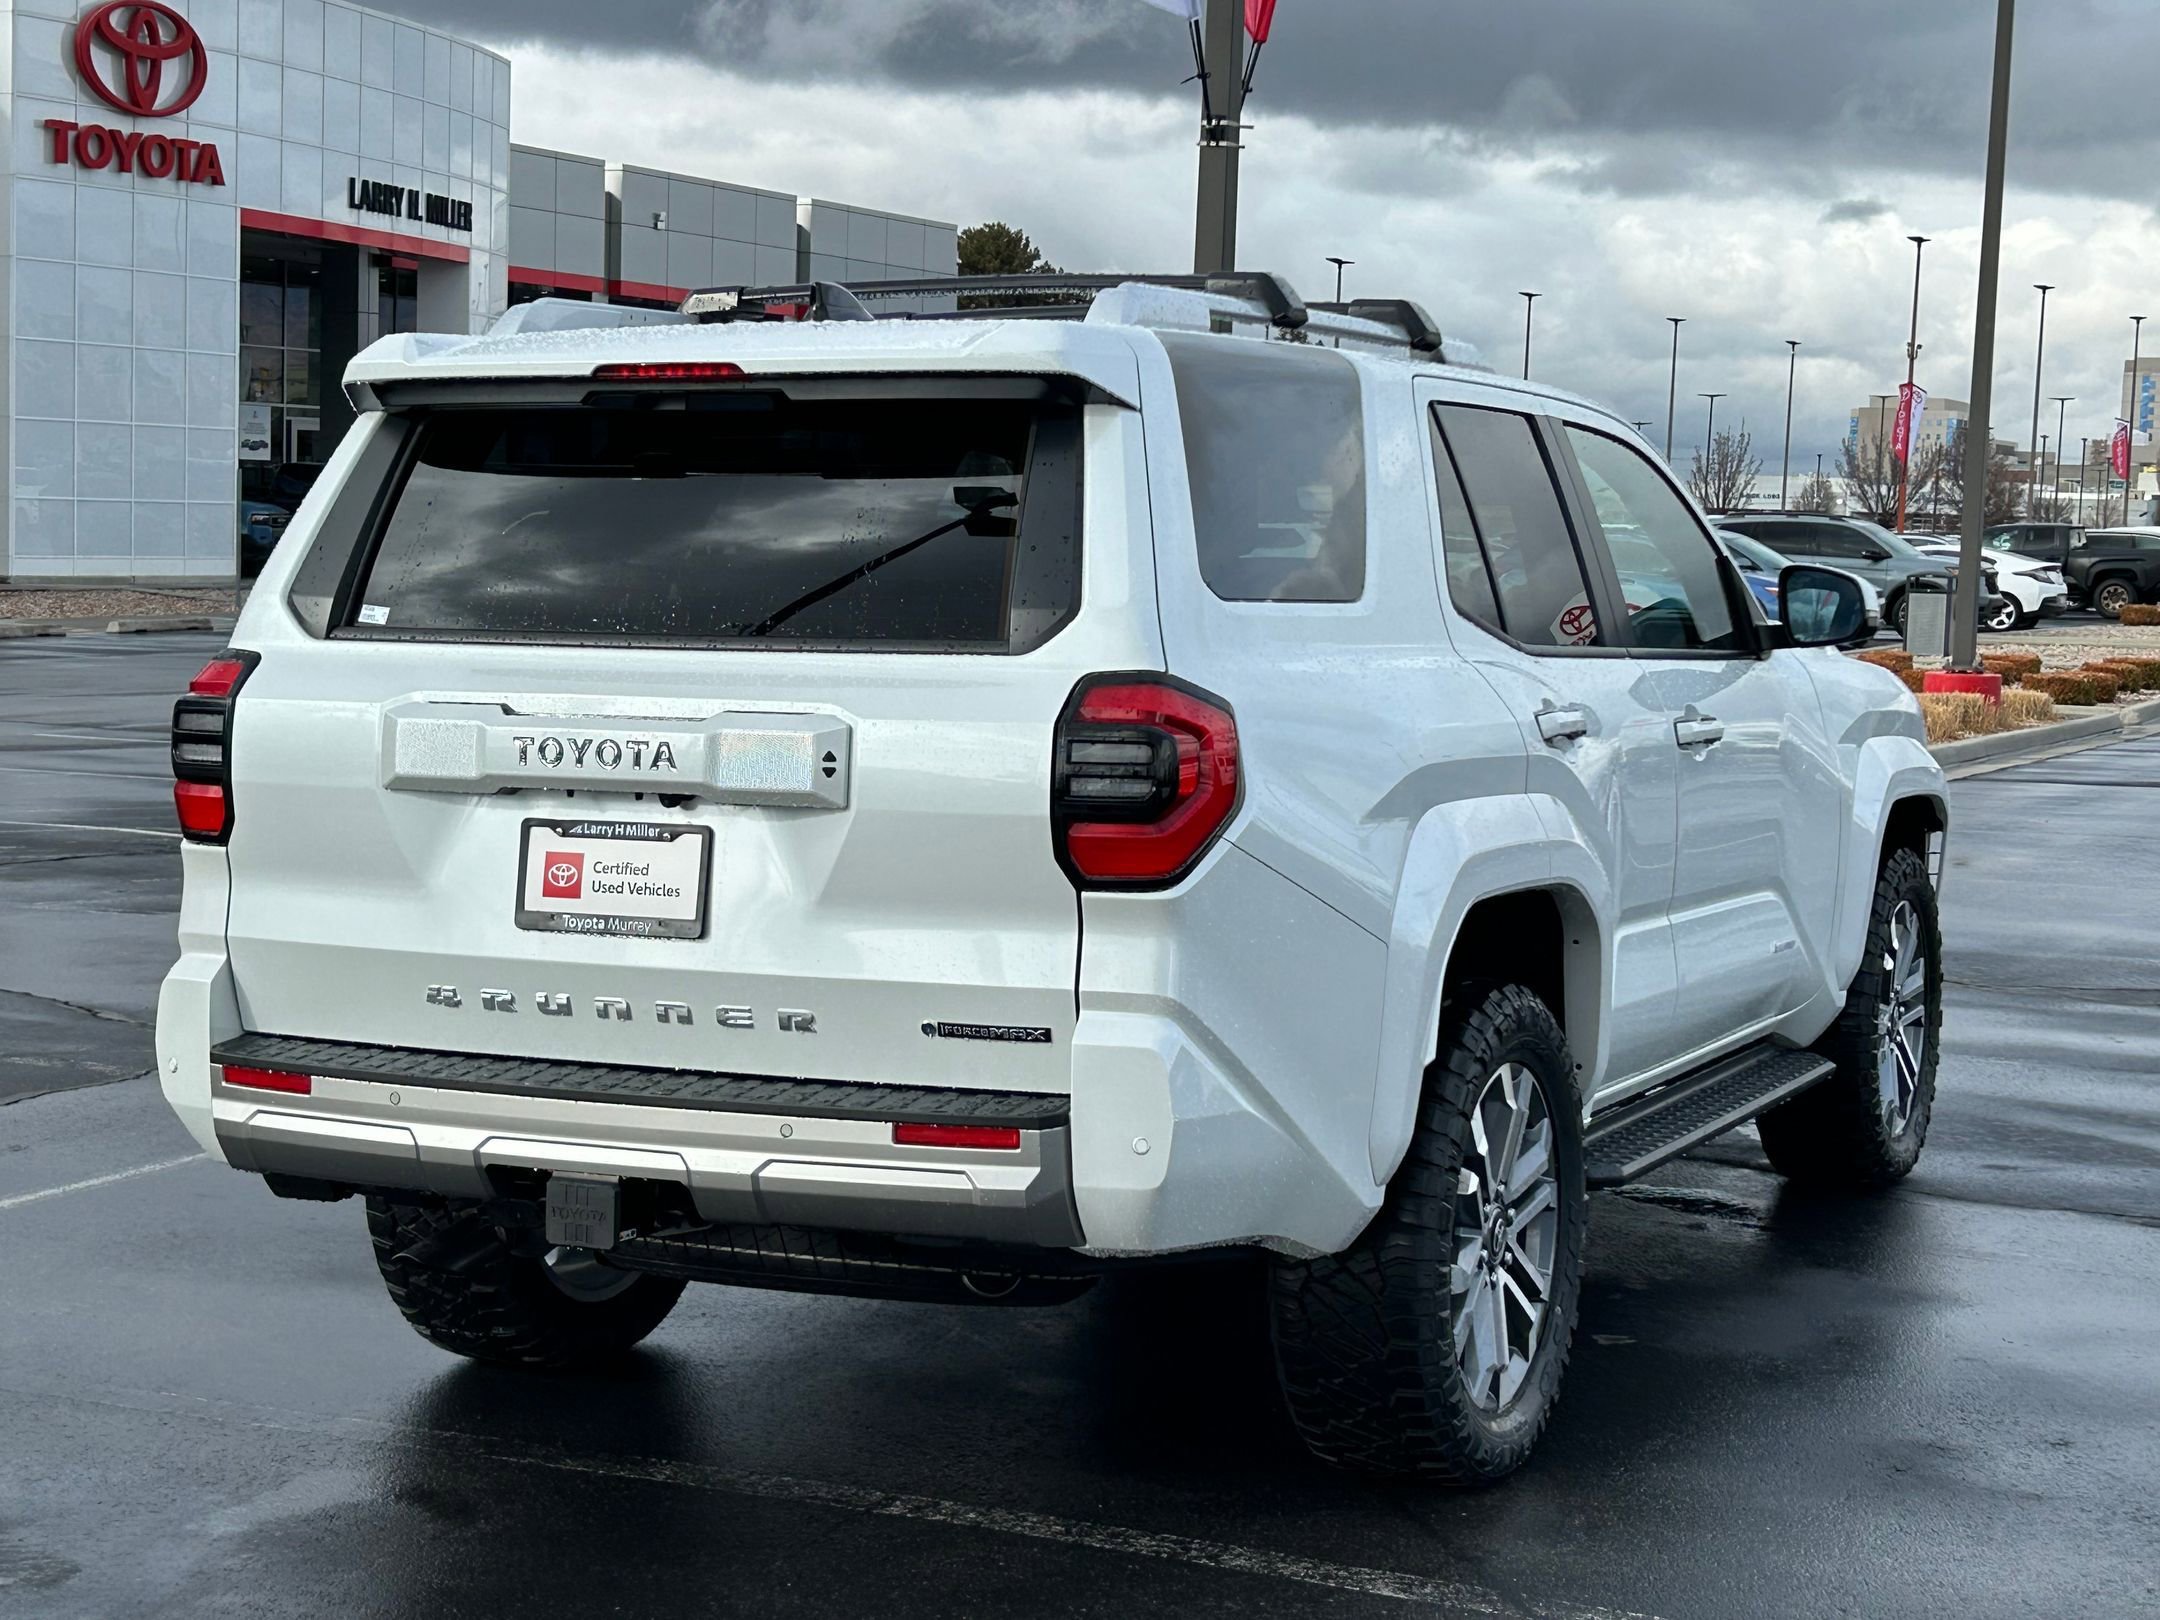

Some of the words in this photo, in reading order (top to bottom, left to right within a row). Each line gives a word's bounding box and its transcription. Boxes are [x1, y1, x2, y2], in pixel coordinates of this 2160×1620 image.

[44, 119, 226, 186] TOYOTA
[348, 177, 404, 217] LARRY
[425, 193, 472, 232] MILLER
[513, 736, 678, 773] TOYOTA
[584, 823, 613, 838] Larry
[615, 824, 624, 835] H
[626, 824, 661, 838] Miller
[593, 861, 650, 876] Certified
[592, 880, 624, 895] Used
[628, 882, 681, 898] Vehicles
[562, 914, 605, 932] Toyota
[607, 917, 652, 934] Murray
[551, 1205, 607, 1222] TOYOTA
